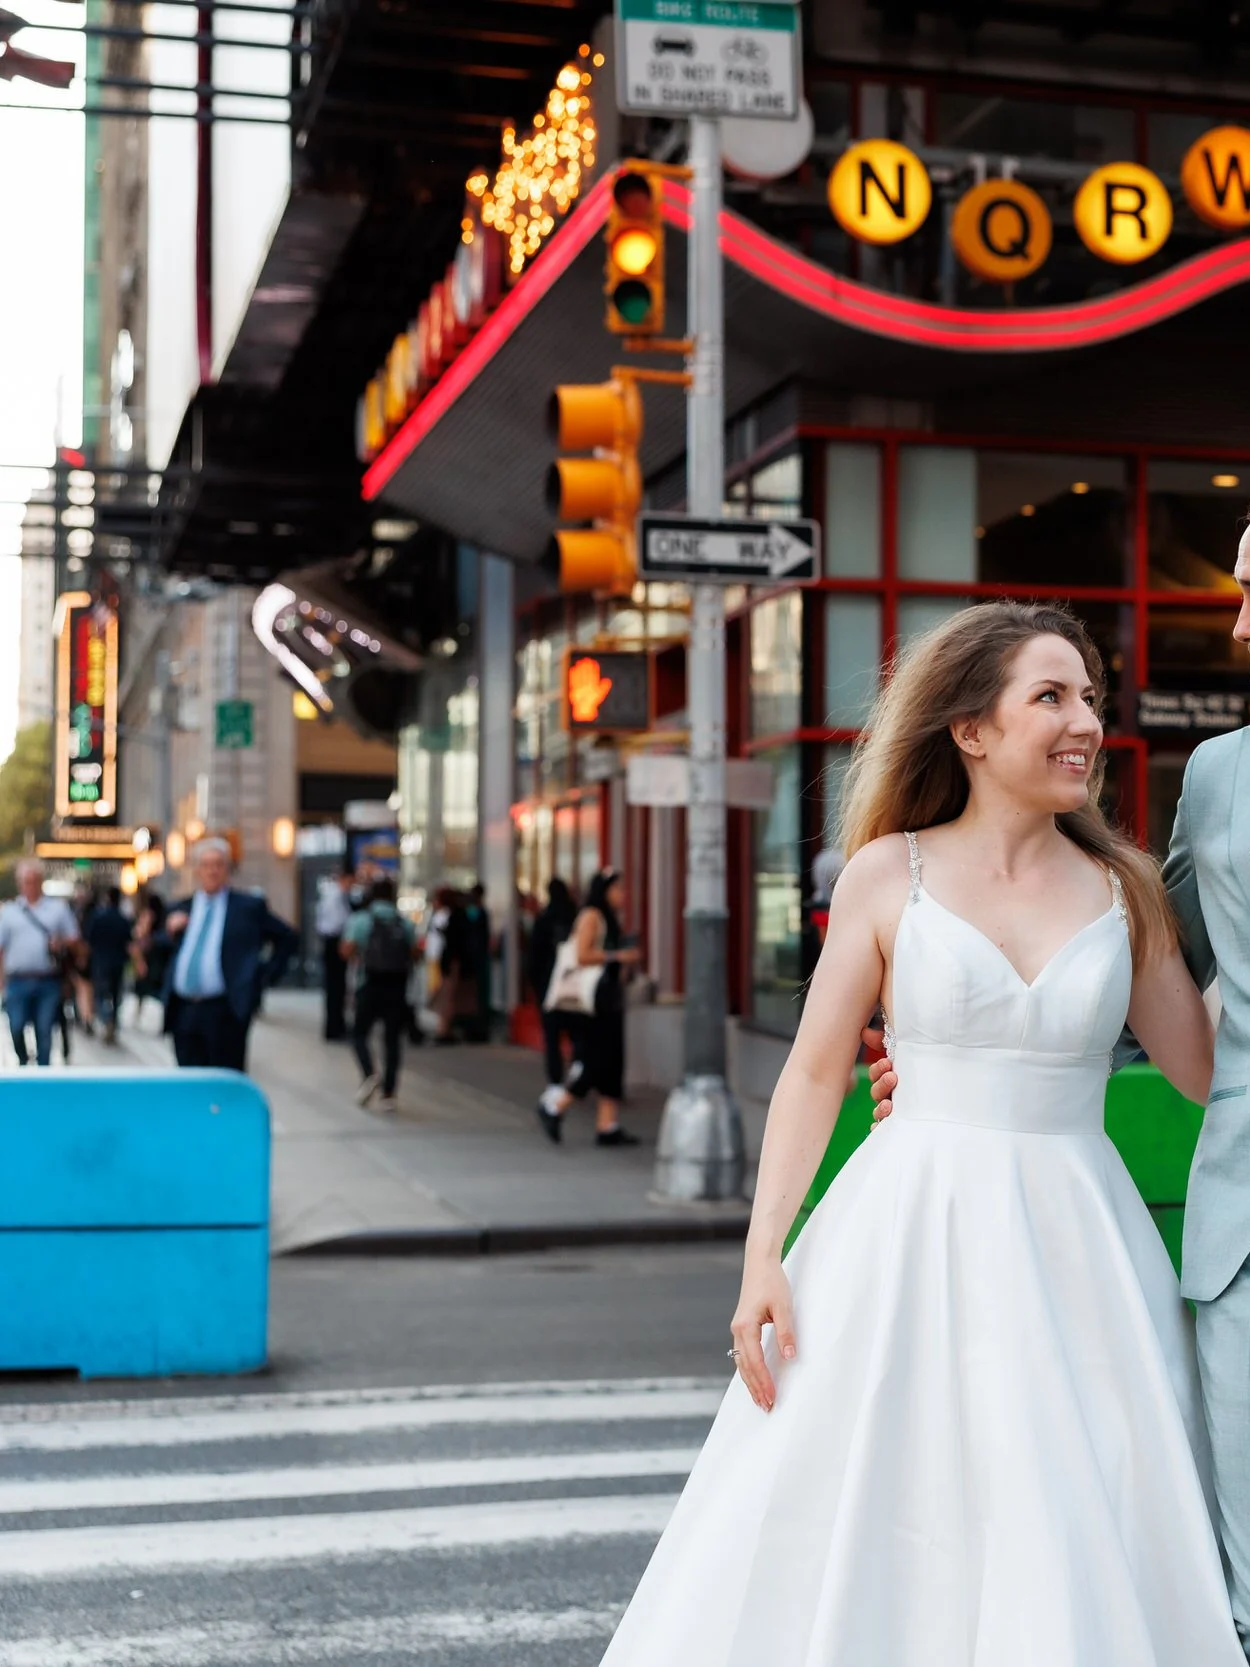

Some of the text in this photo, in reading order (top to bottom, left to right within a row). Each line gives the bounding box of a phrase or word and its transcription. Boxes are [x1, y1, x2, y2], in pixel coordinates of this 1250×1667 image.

[705, 3, 760, 22] ROUTE
[648, 63, 774, 87] DO NOT PASS
[634, 85, 787, 110] IN SHARED LANE
[857, 158, 908, 220] N
[978, 196, 1032, 264] Q
[1104, 181, 1150, 241] R
[653, 532, 793, 563] ONE WAY
